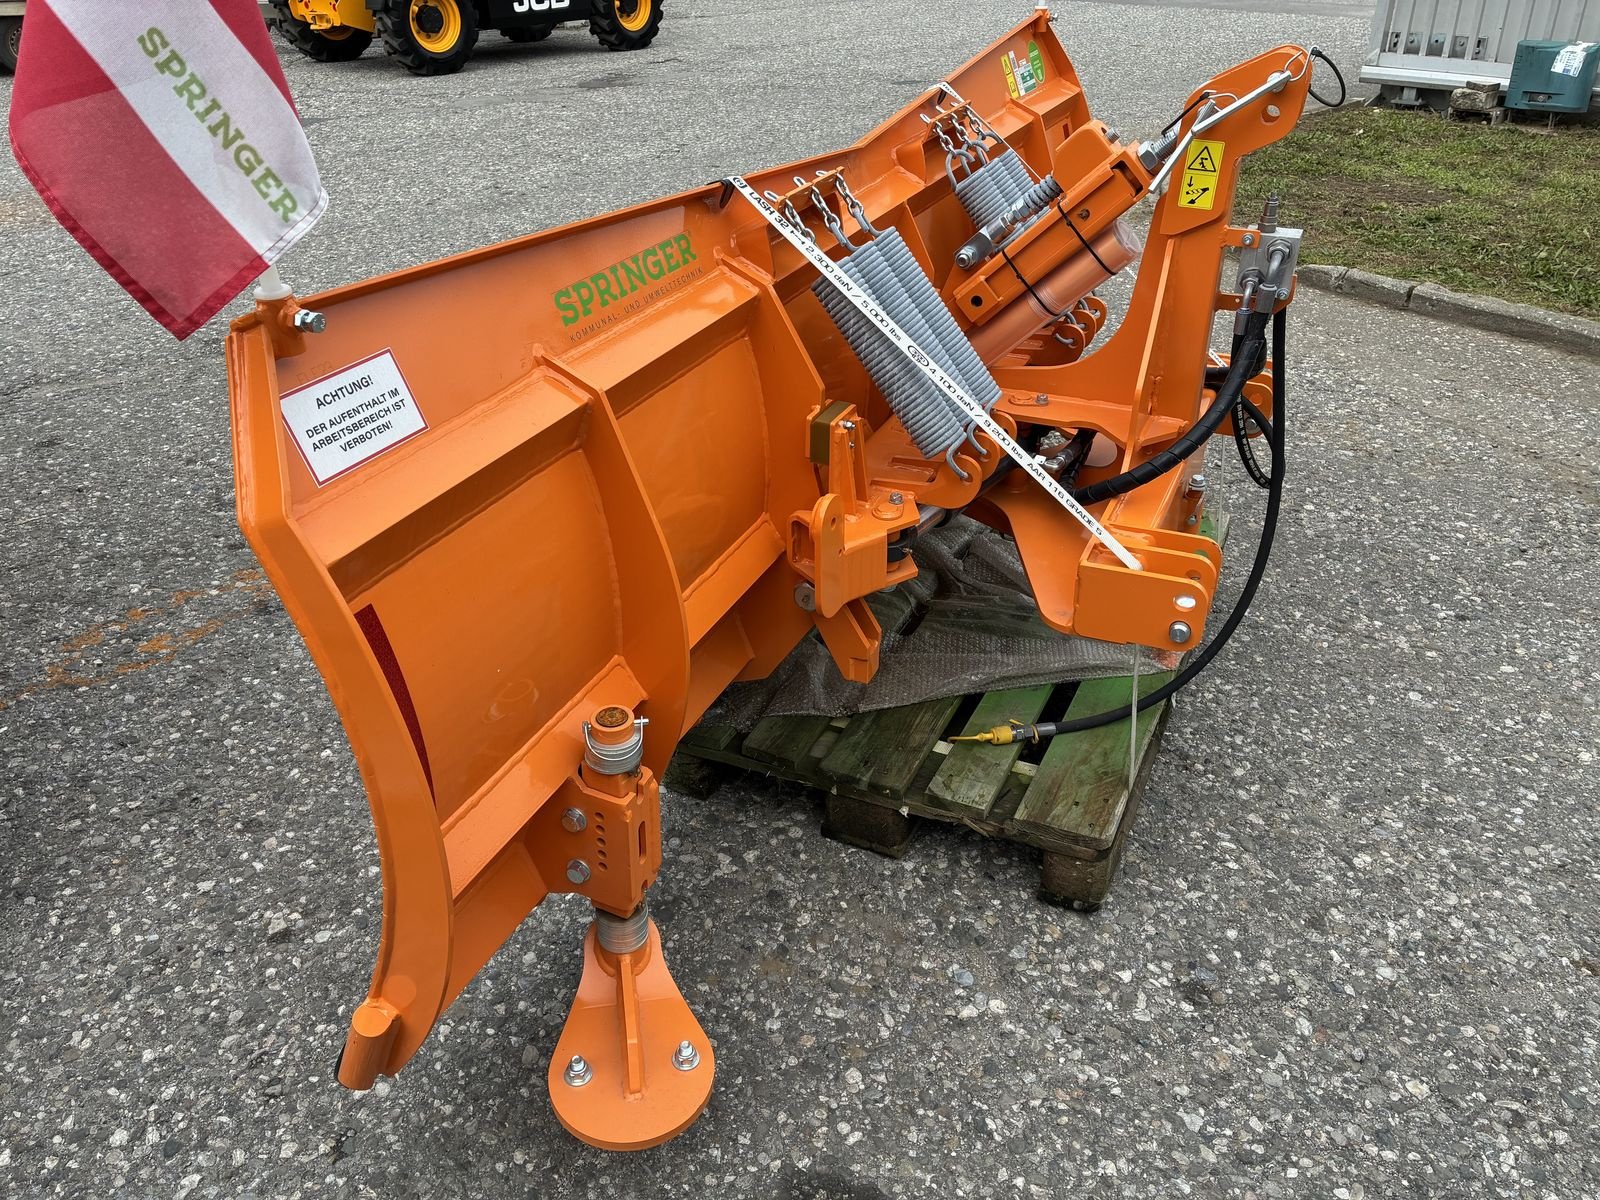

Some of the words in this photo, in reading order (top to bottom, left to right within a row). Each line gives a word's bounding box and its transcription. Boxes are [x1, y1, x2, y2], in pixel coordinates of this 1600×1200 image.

[137, 27, 298, 223] SPRINGER
[554, 233, 697, 327] SPRINGER
[749, 191, 776, 215] LASH
[775, 215, 789, 230] 32
[805, 246, 835, 274] 2.300
[833, 274, 853, 292] daN
[860, 300, 889, 328] 5.000
[889, 328, 901, 341] lbs
[570, 312, 621, 342] KOMMUNAL-
[624, 301, 641, 314] UND
[643, 267, 703, 303] UMWELTTECHNIK
[306, 422, 327, 439] DER
[329, 393, 387, 428] AUFENTHALT
[388, 387, 400, 400] IM
[312, 405, 392, 452] ARBEITSBEREICH
[392, 398, 406, 412] IST
[316, 375, 373, 409] ACHTUNG!
[340, 420, 393, 452] VERBOTEN!
[929, 367, 956, 394] 4.100
[956, 393, 975, 411] daN
[983, 419, 1011, 446] 9.200
[1011, 445, 1023, 460] lbs
[1027, 462, 1046, 481] AAR
[1065, 499, 1095, 527] GRADE
